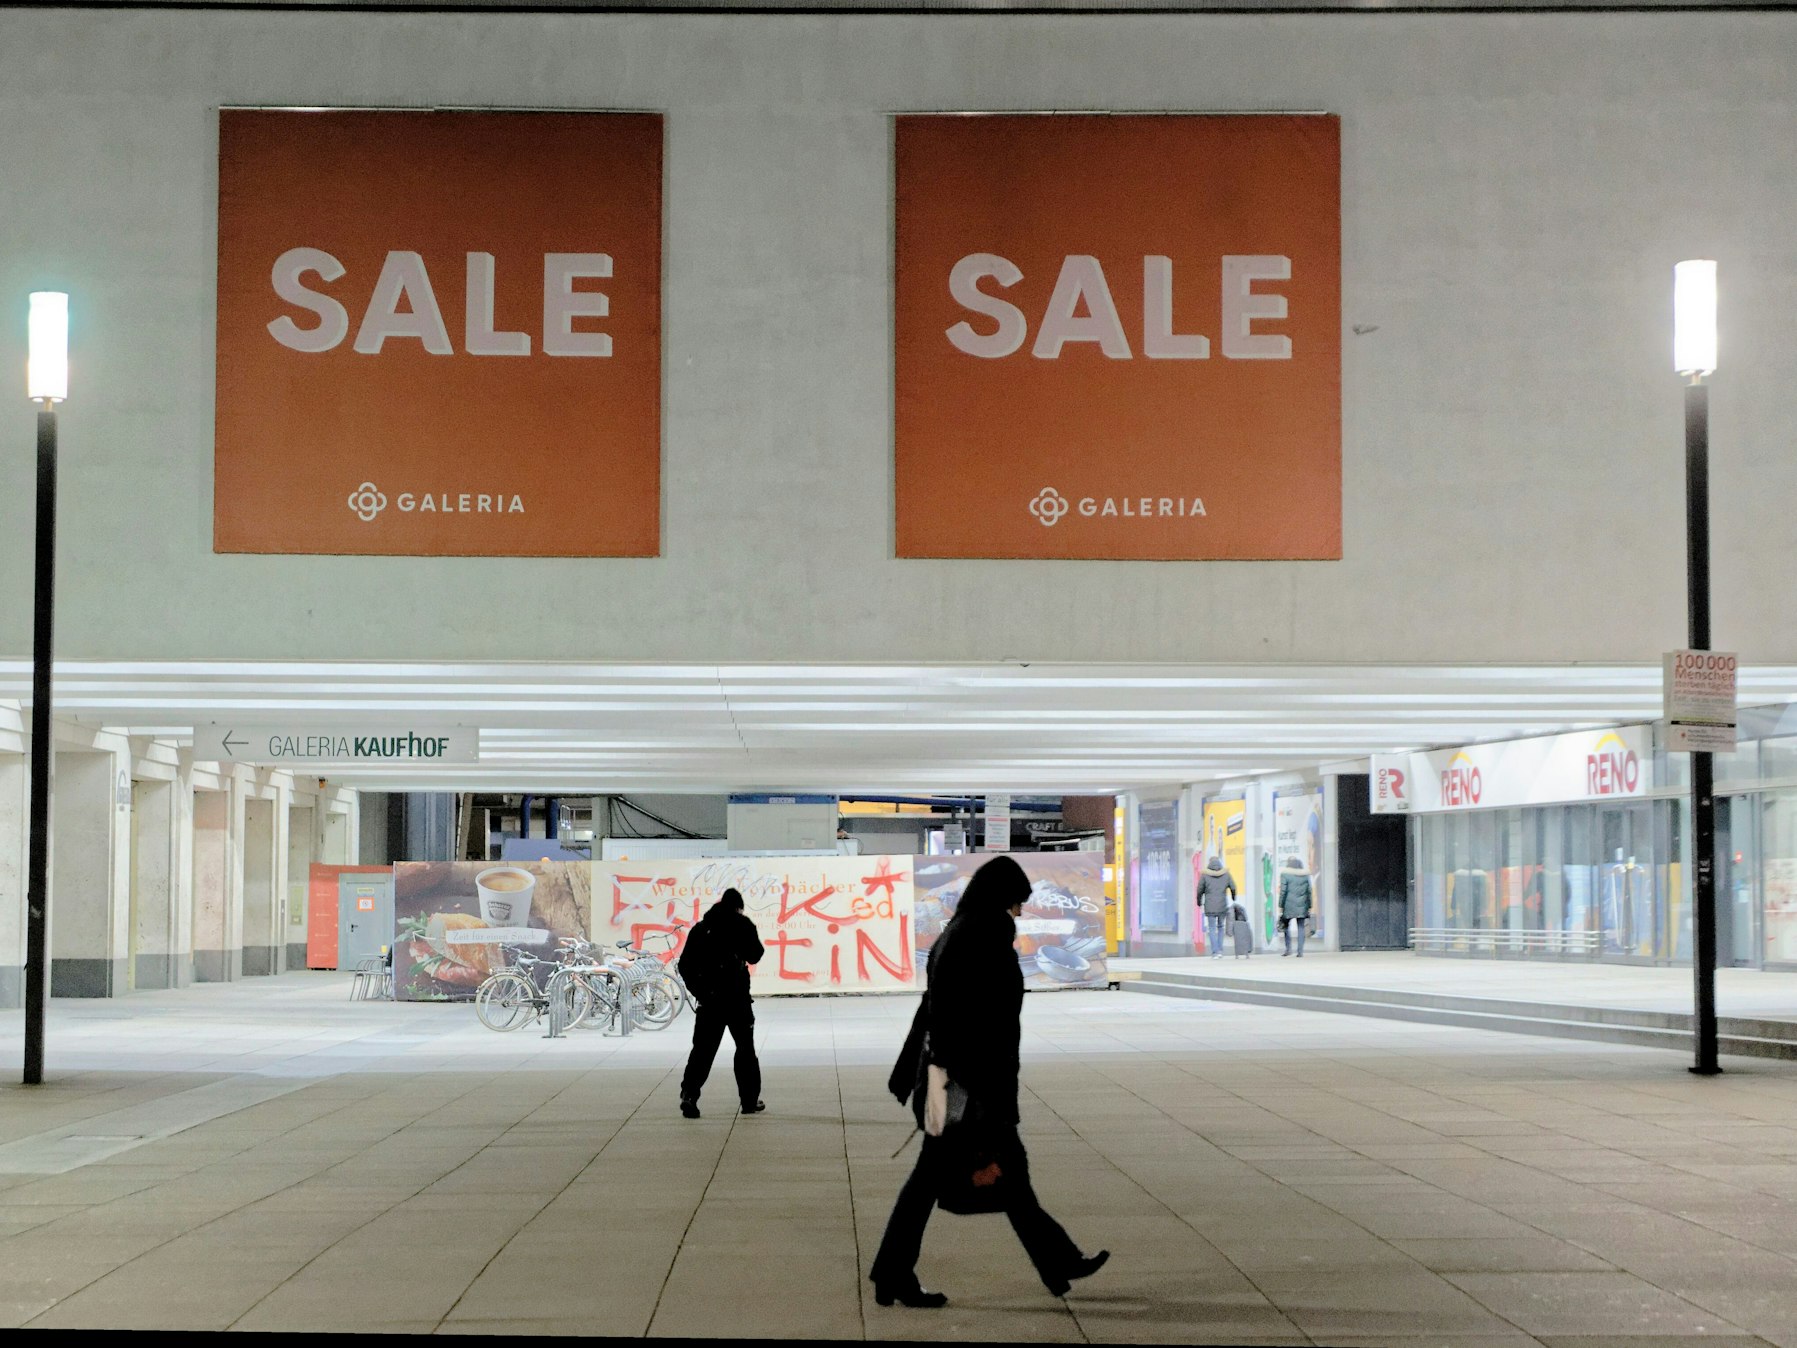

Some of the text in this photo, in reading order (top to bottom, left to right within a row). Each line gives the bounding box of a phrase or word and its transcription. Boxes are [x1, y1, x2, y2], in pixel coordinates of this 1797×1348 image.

[266, 246, 614, 358] SALE
[945, 252, 1293, 359] SALE
[397, 493, 525, 513] GALERIA
[1078, 497, 1207, 517] GALERIA
[1675, 668, 1735, 681] Menschen
[269, 735, 350, 757] GALERIA
[1379, 768, 1387, 799] RENO
[1587, 750, 1639, 795] RENO
[1441, 766, 1482, 806] RENO
[652, 883, 722, 897] Wiene
[453, 930, 536, 942] Zeit für einen Snack
